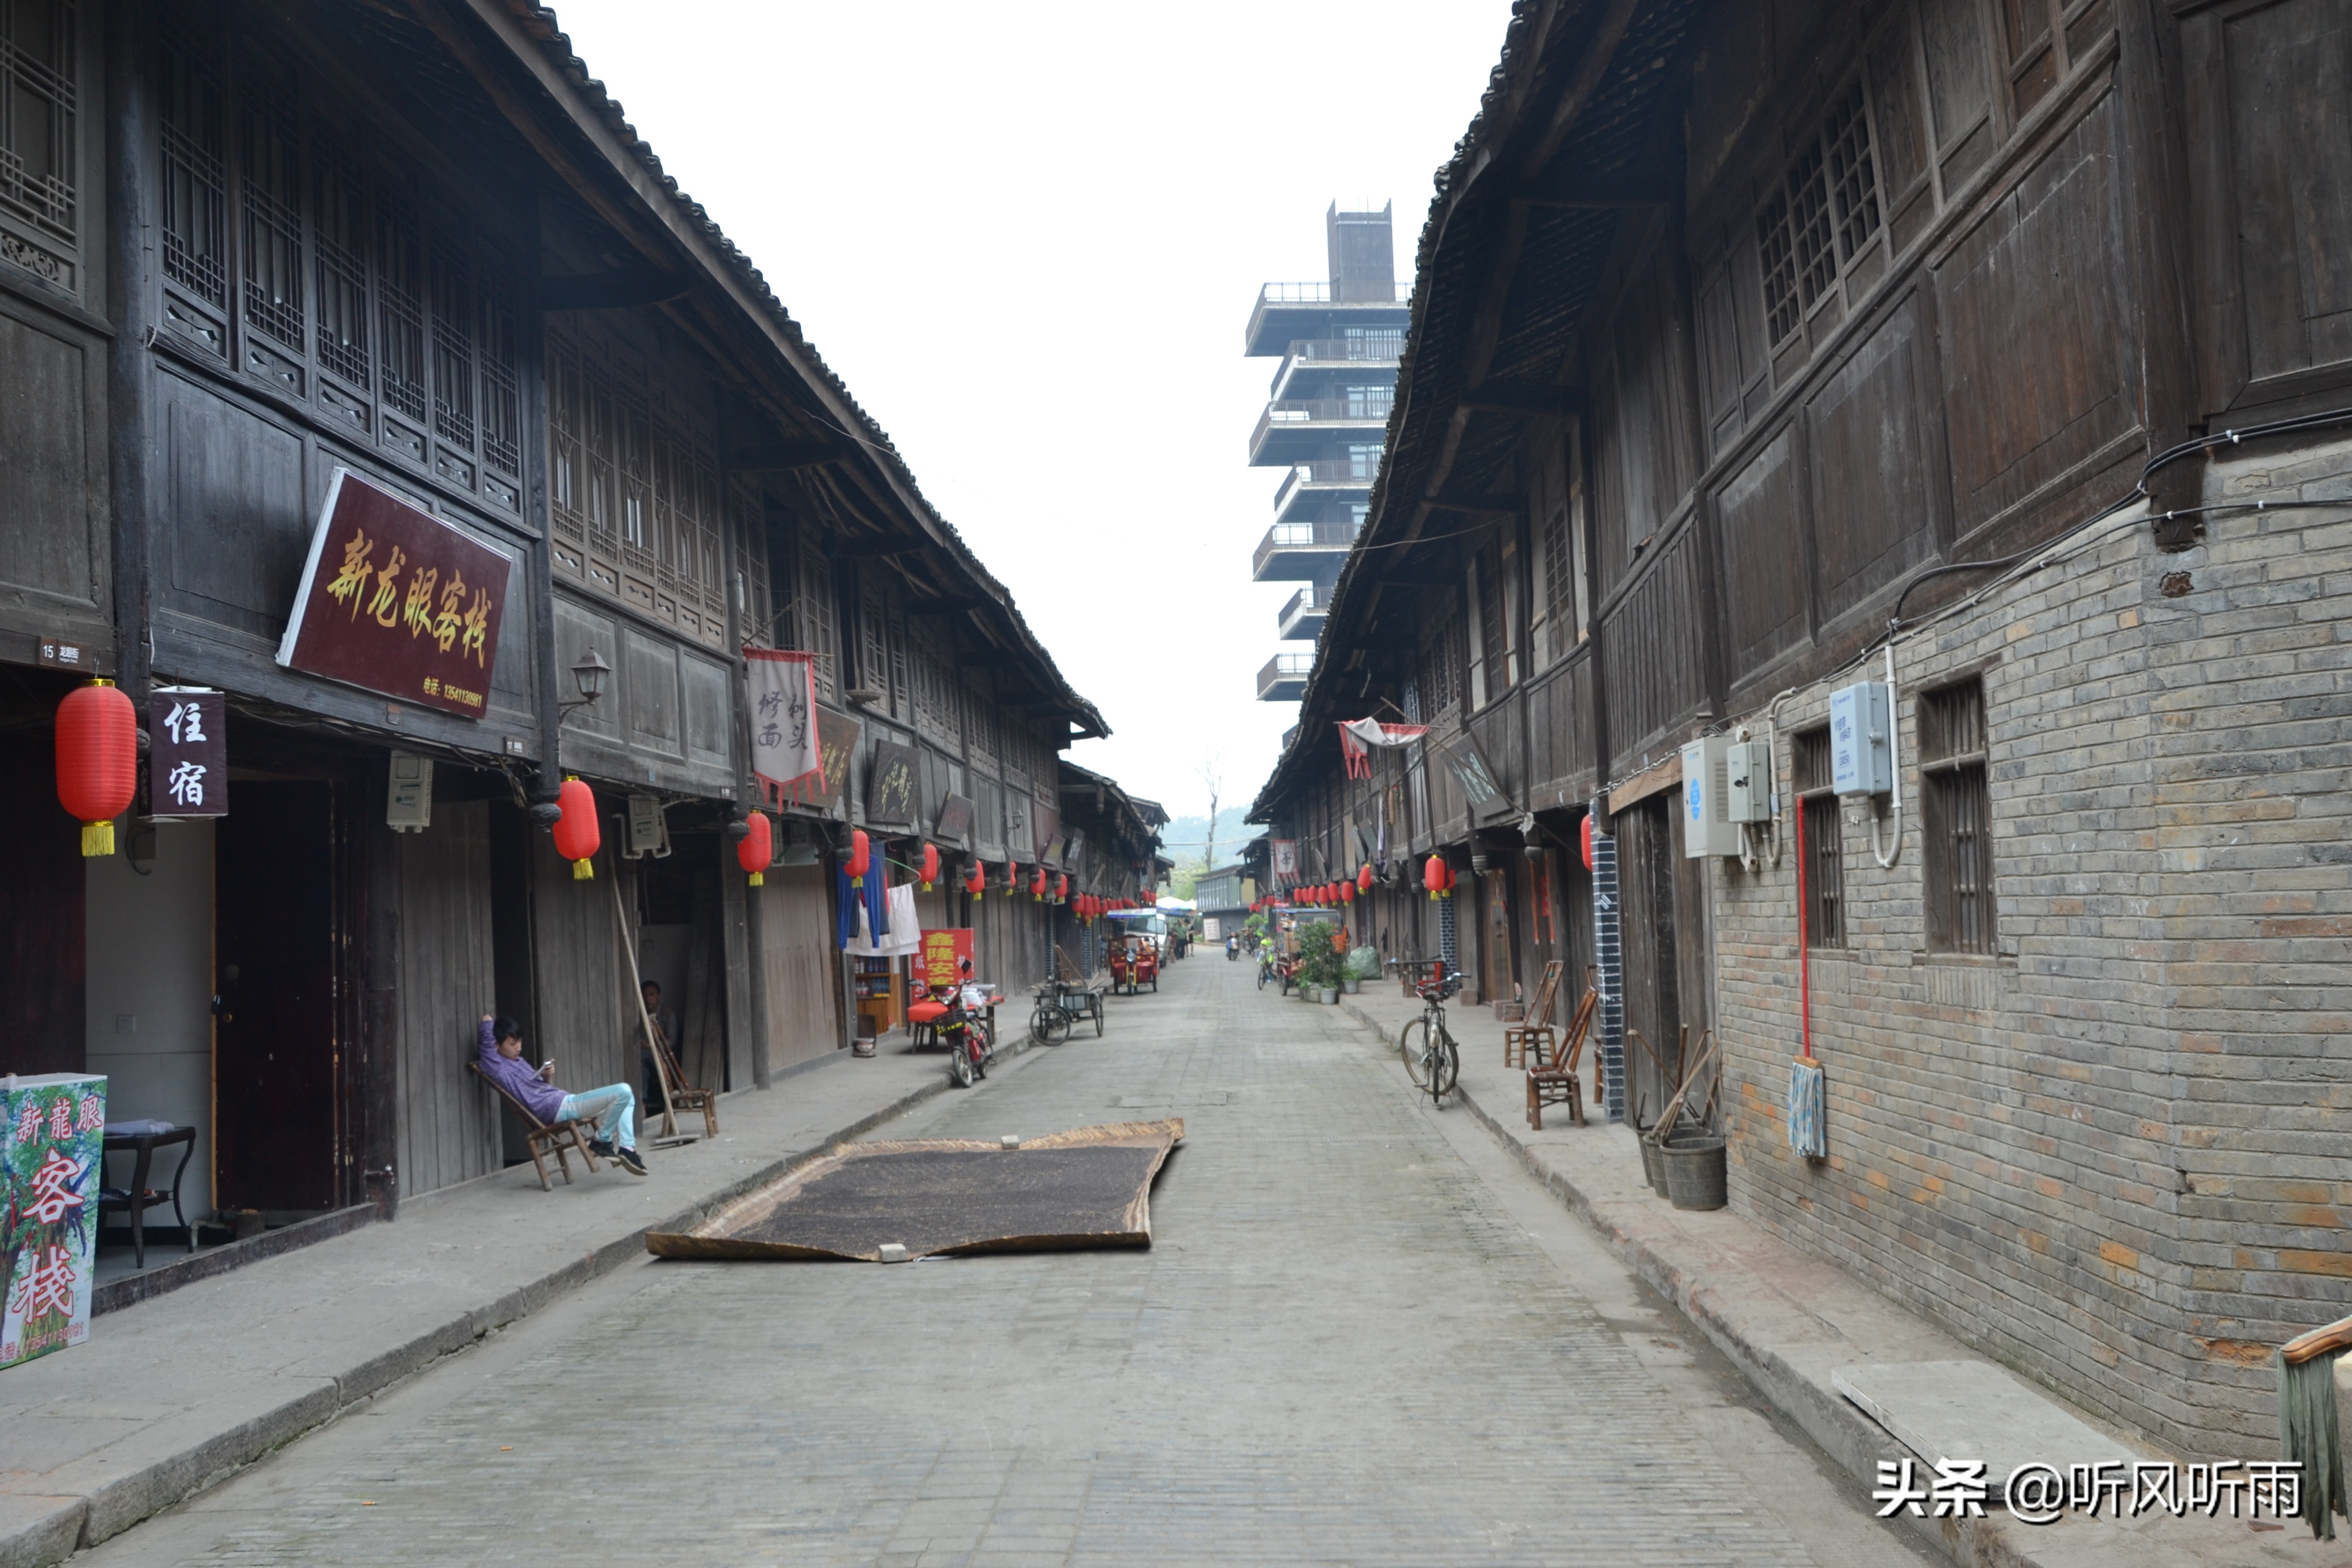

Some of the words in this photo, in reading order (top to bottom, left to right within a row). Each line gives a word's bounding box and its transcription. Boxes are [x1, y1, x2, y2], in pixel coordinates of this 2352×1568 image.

[327, 527, 492, 669] 新龙眼客栈
[43, 645, 54, 658] 15
[164, 702, 207, 806] 住宿
[16, 1094, 103, 1147] 新龍眼
